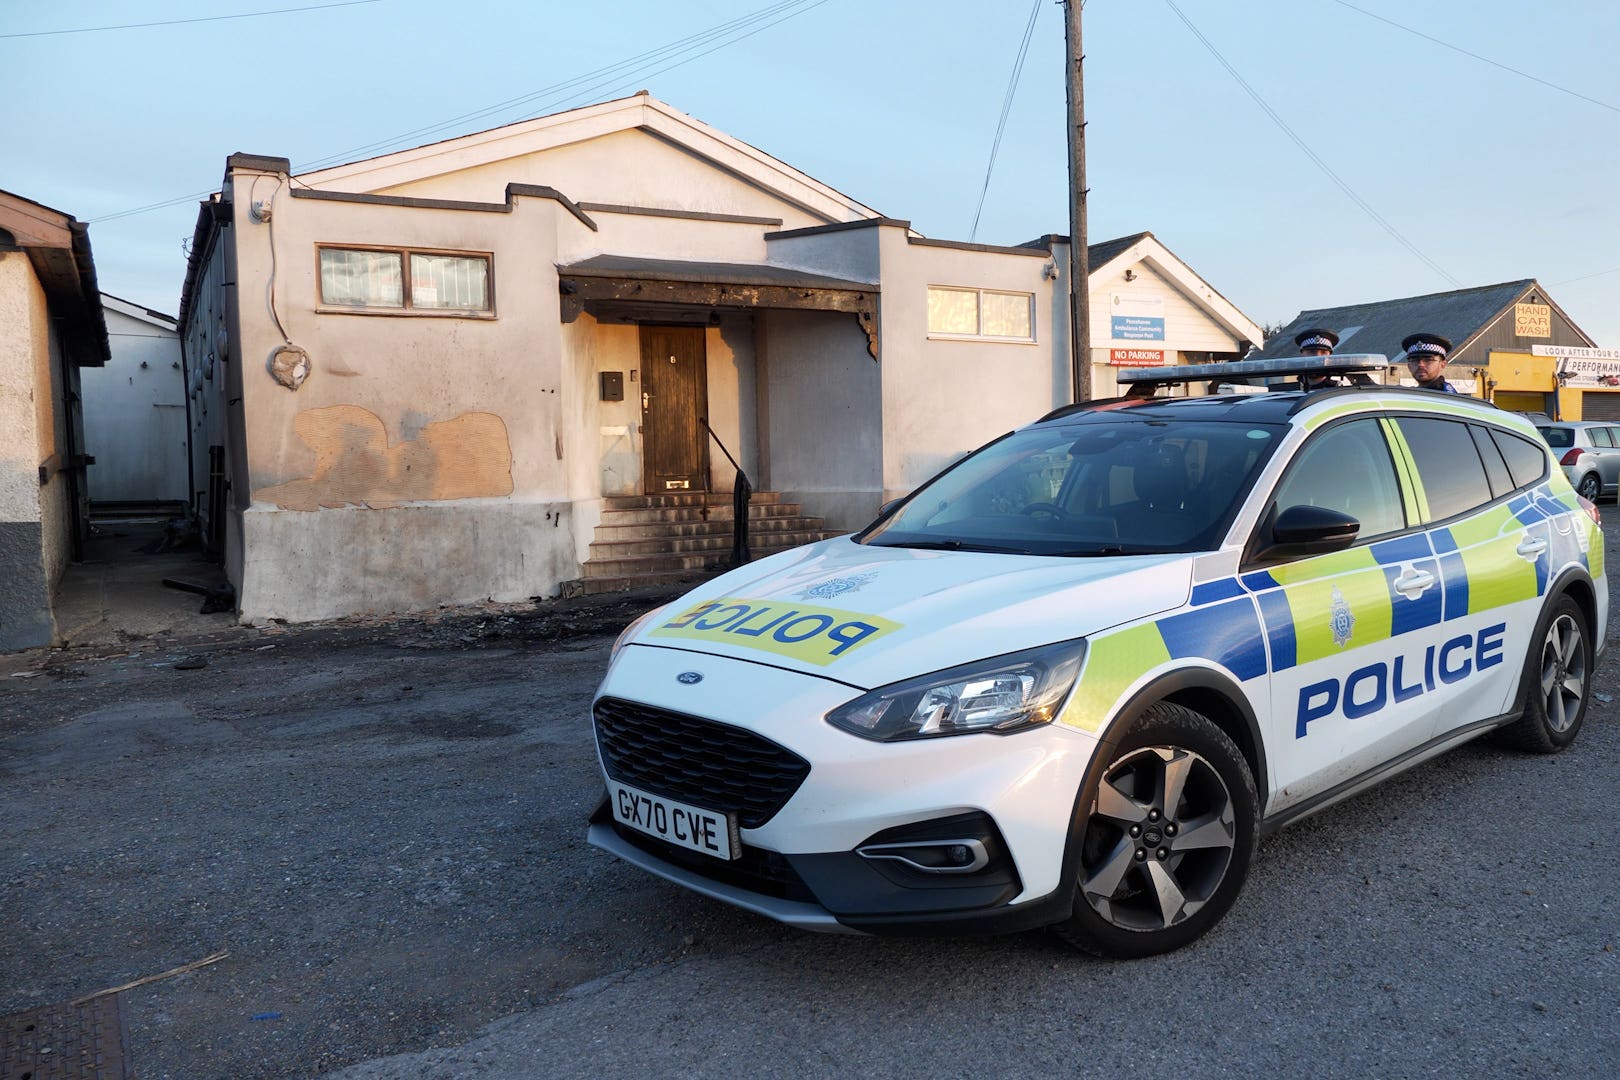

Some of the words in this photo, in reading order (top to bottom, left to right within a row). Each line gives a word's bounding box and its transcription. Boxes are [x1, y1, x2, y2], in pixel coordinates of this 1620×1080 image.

[1517, 306, 1548, 316] HAND
[1517, 316, 1548, 326] CAR
[1516, 325, 1549, 335] WASH
[1114, 350, 1127, 359] NO
[1128, 350, 1161, 360] PARKING
[1545, 347, 1565, 355] LOOK
[1568, 349, 1590, 357] AFTER
[1592, 350, 1611, 358] YOUR
[1295, 622, 1506, 740] POLICE
[618, 788, 668, 835] GX70
[672, 808, 719, 852] CVE
